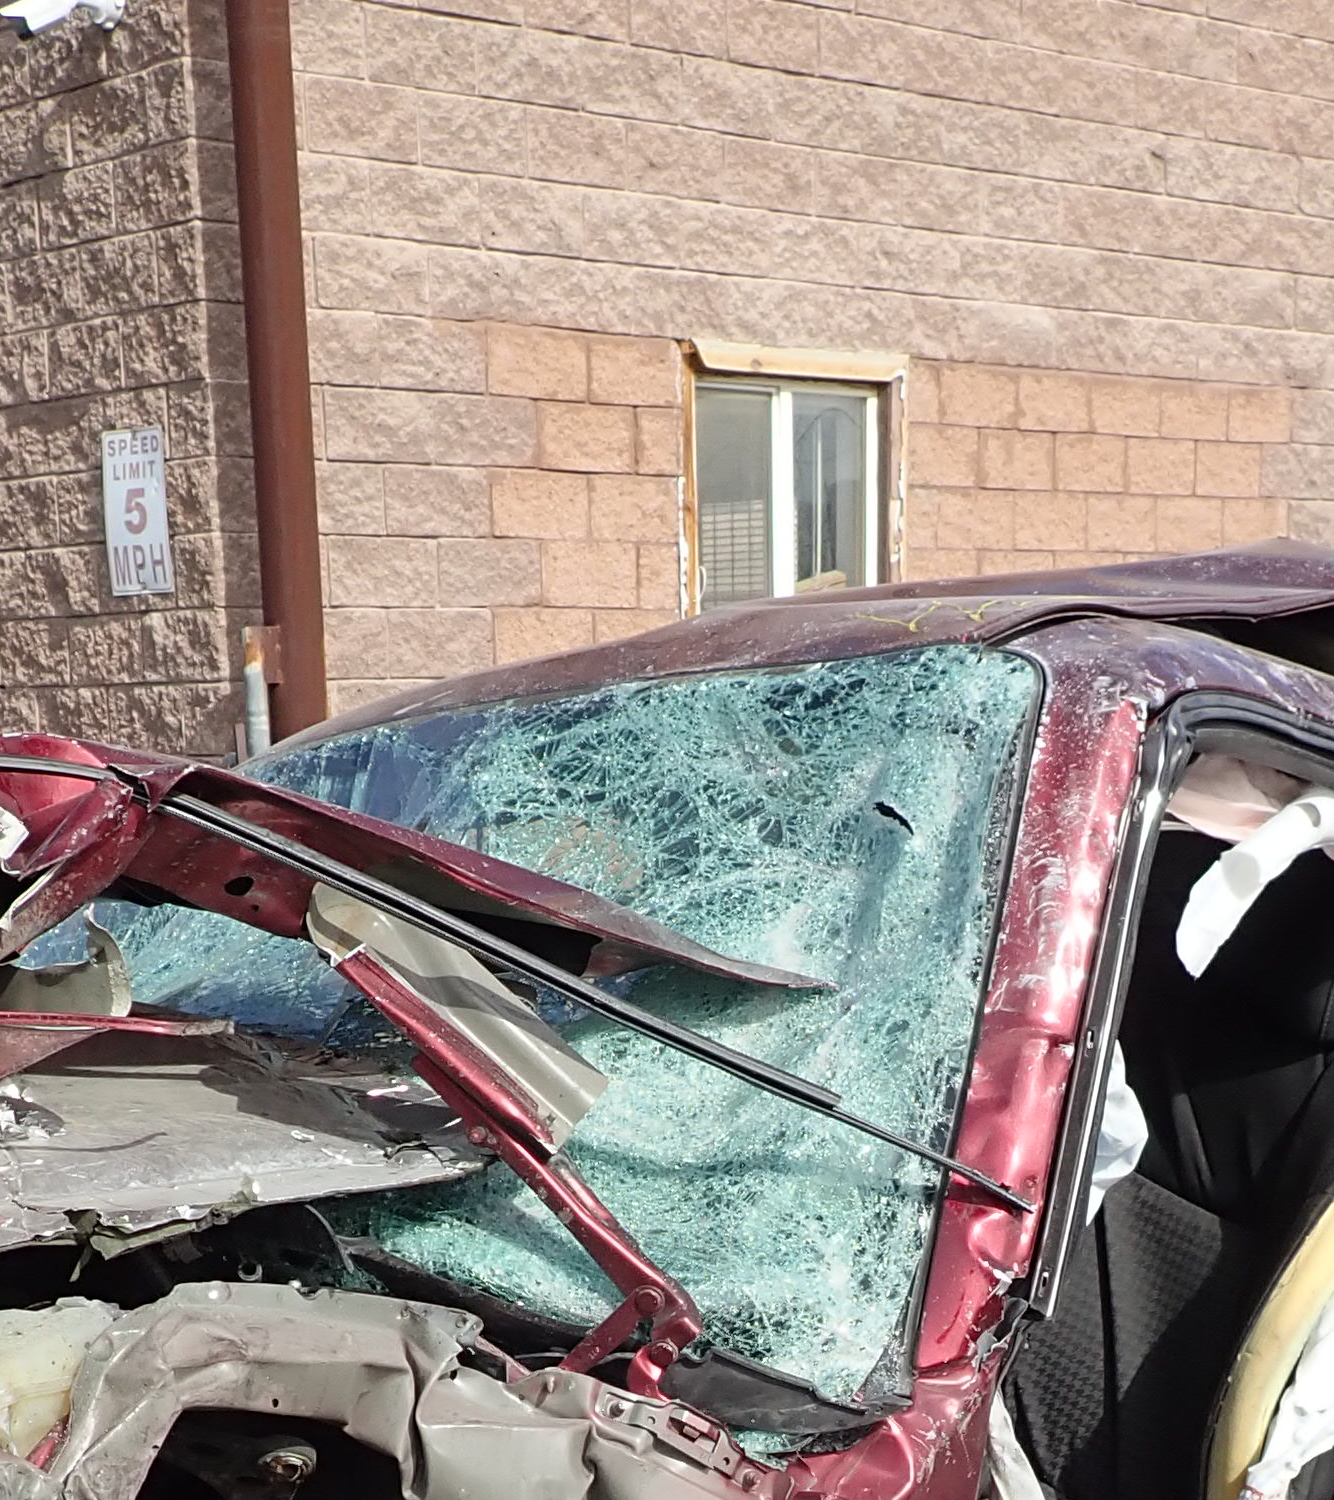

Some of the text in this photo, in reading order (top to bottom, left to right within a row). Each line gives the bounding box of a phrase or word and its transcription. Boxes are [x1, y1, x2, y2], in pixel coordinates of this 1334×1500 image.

[107, 435, 159, 457] SPEED
[112, 460, 156, 481] LIMIT
[123, 487, 148, 535] 5
[113, 543, 167, 586] MPH
